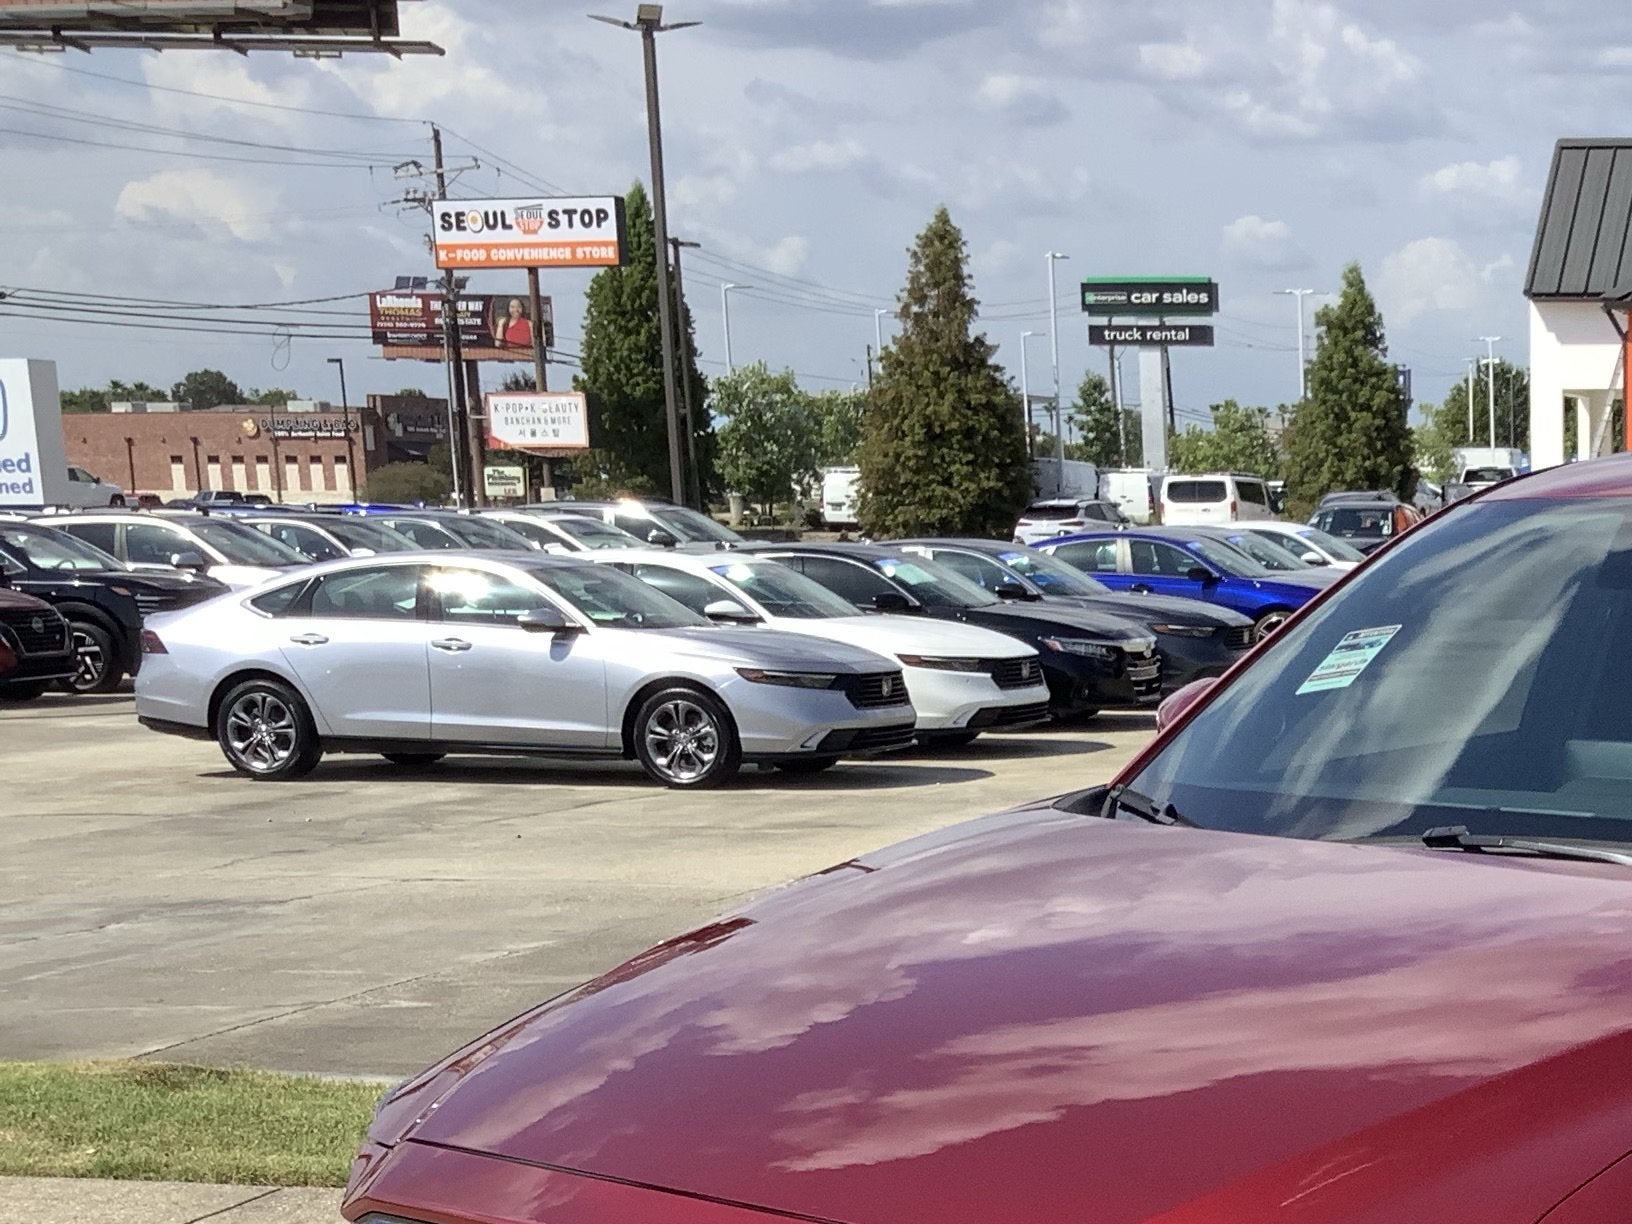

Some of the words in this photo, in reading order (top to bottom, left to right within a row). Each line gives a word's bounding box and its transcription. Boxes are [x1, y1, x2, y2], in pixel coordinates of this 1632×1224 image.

[440, 209, 513, 233] SEOUL
[547, 208, 609, 229] STOP
[439, 248, 487, 262] K-FOOD
[490, 247, 572, 260] CONVENIENCE
[576, 246, 616, 259] STORE
[1130, 292, 1160, 304] car
[1162, 288, 1209, 304] sales
[379, 308, 422, 316] THOMAS
[1104, 327, 1143, 341] truck
[1146, 327, 1190, 341] rental
[504, 416, 541, 425] BANCHAN
[0, 452, 32, 473] ed
